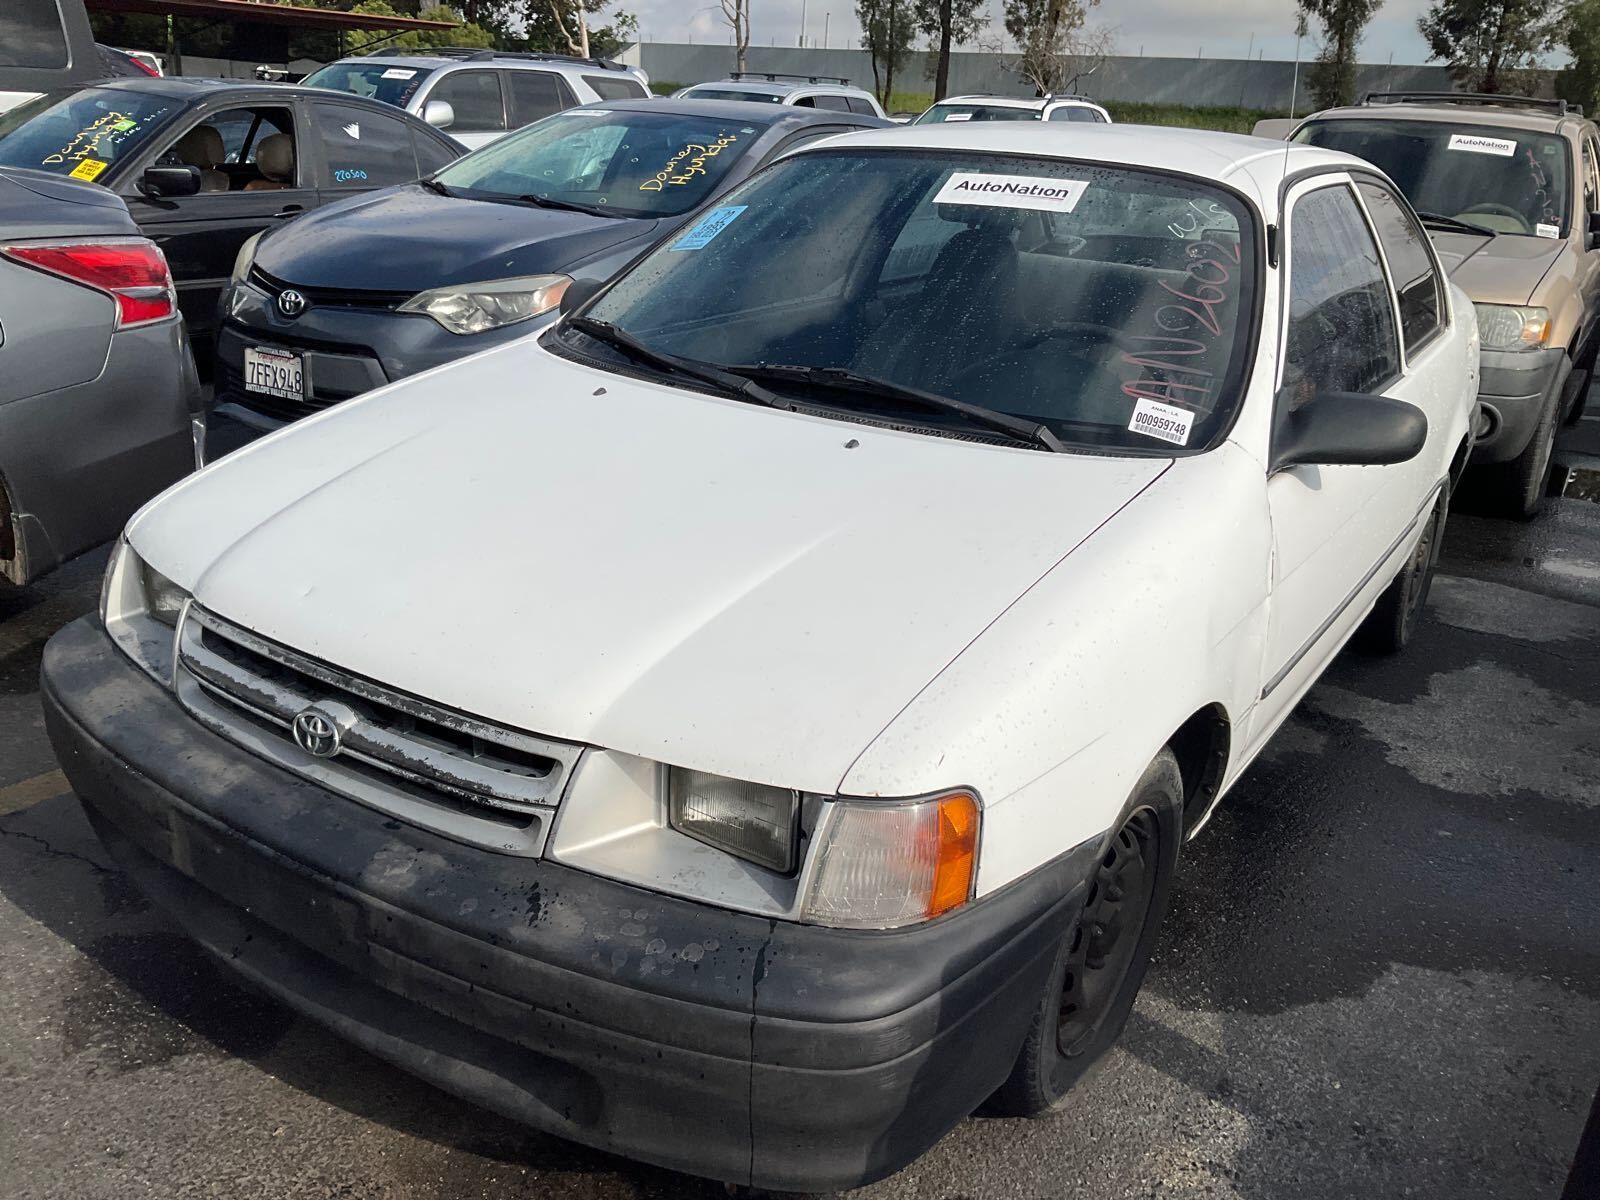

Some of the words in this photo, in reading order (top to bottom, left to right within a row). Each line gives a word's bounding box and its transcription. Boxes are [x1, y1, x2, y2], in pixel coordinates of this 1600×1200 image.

[1456, 138, 1509, 150] AutoNation
[640, 144, 706, 192] Downey
[668, 134, 737, 185] Hyundai
[954, 180, 1069, 199] AutoNation
[248, 361, 302, 392] 7FFX948
[1135, 412, 1187, 436] 000959748
